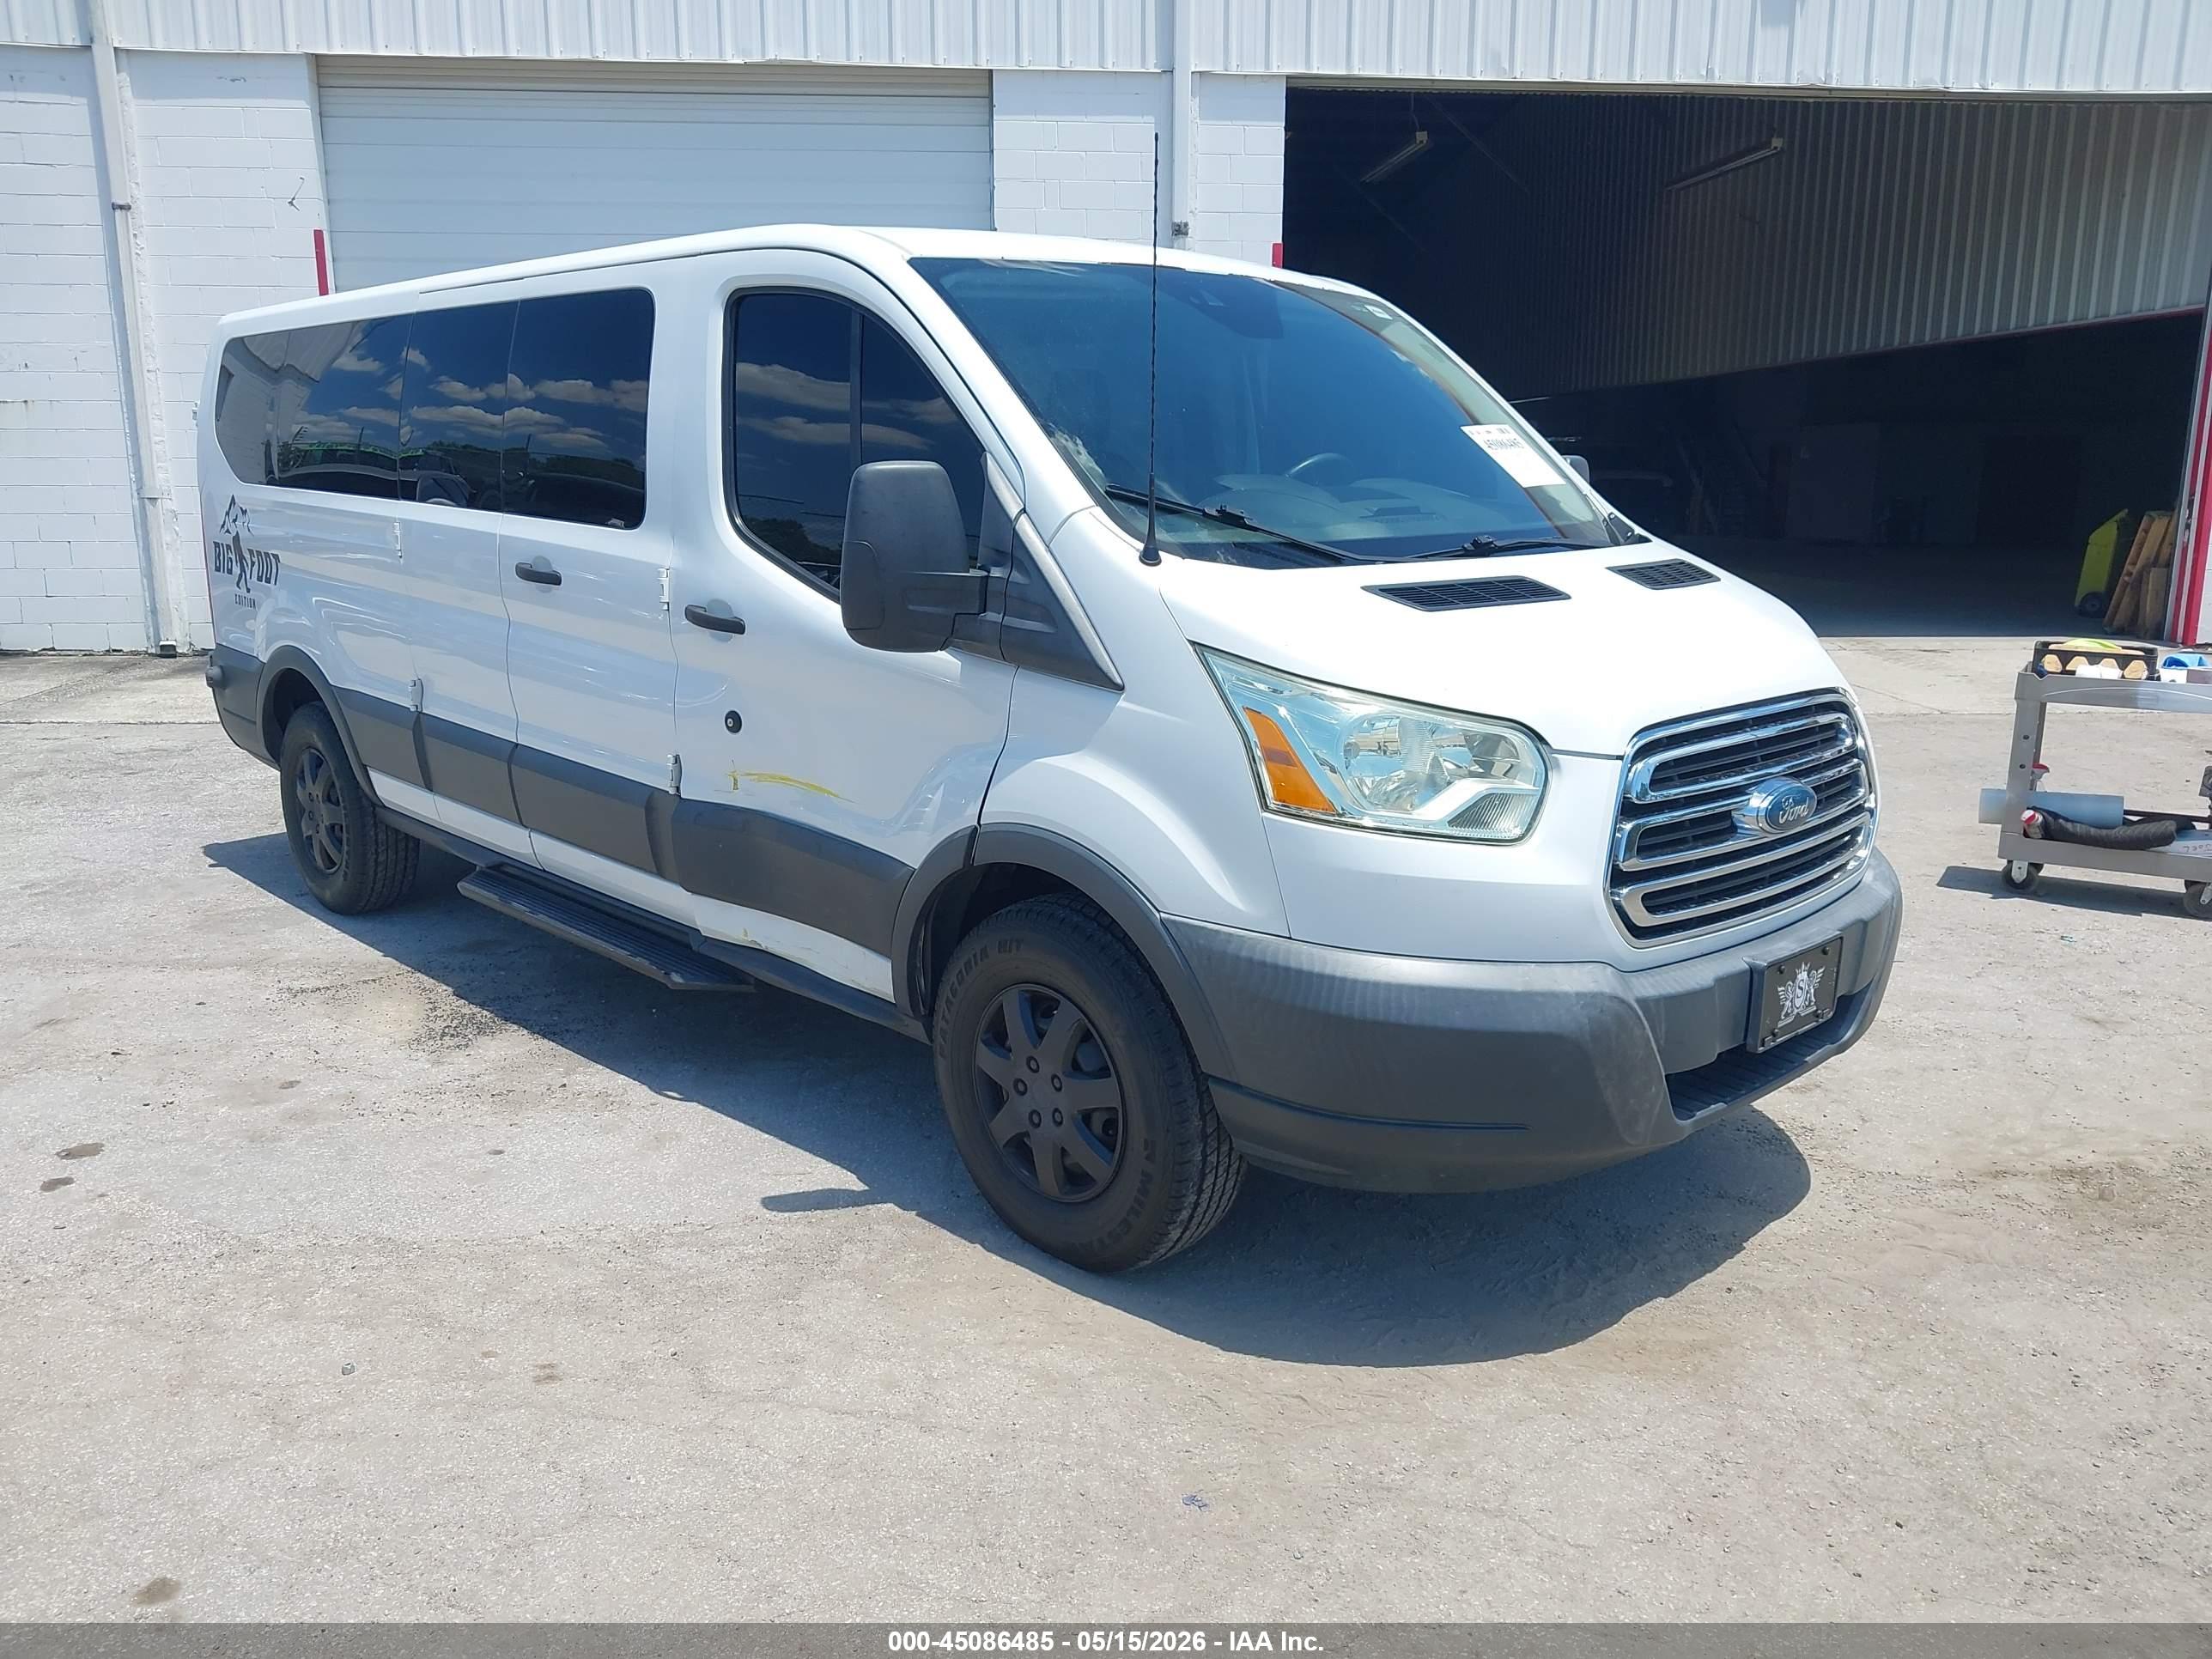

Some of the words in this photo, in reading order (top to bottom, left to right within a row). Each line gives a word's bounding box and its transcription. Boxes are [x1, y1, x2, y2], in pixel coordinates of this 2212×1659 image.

[212, 540, 234, 575] BIG
[246, 548, 281, 586] FOOT
[234, 593, 257, 609] EDITION
[1778, 794, 1809, 824] Ford
